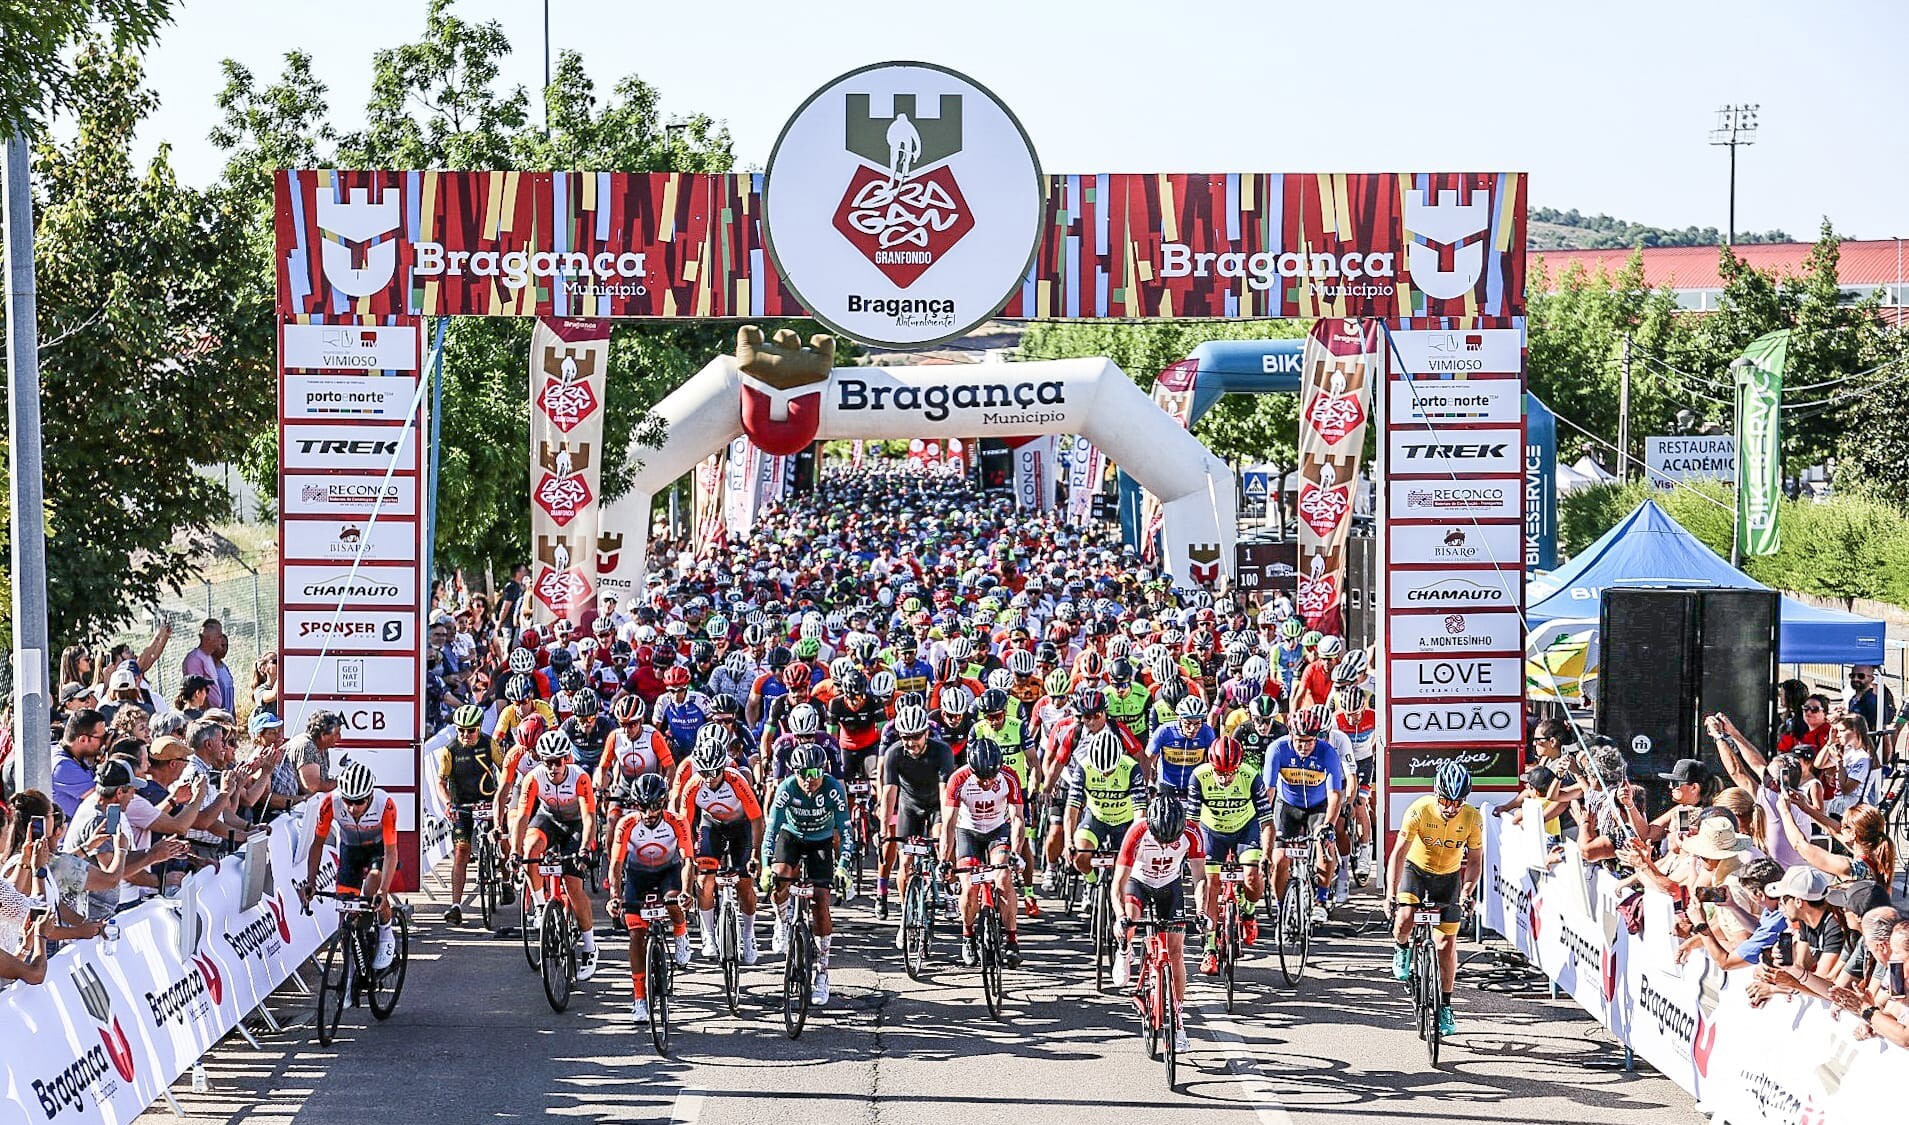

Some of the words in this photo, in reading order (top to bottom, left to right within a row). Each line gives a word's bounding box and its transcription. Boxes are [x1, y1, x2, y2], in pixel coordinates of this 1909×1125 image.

[412, 241, 647, 288] Bragança
[875, 251, 932, 265] GRANFONDO
[1160, 244, 1395, 290] Bragança
[561, 280, 647, 299] Município
[1308, 282, 1395, 299] Município
[848, 295, 955, 317] Bragança
[323, 355, 377, 367] VIMIOSO
[1428, 359, 1483, 371] VIMIOSO
[837, 378, 1066, 420] Bragança
[982, 410, 1066, 425] Município
[295, 439, 399, 455] TREK
[1401, 443, 1509, 459] TREK
[1434, 489, 1503, 500] RECONCO
[1525, 444, 1541, 566] BIKESERVICE
[1245, 548, 1252, 561] 1
[1240, 573, 1259, 587] 100
[303, 585, 399, 597] CHAMAUTO
[1407, 589, 1502, 600] CHAMAUTO
[299, 622, 376, 637] SPONSER
[342, 665, 358, 673] GEO
[1419, 662, 1492, 685] LOVE
[1403, 706, 1512, 732] CADÃO
[1455, 750, 1491, 763] doce
[223, 911, 277, 960] Bragança
[145, 968, 205, 1028] Bragança
[1639, 973, 1695, 1043] Bragança
[31, 1043, 110, 1120] Bragança
